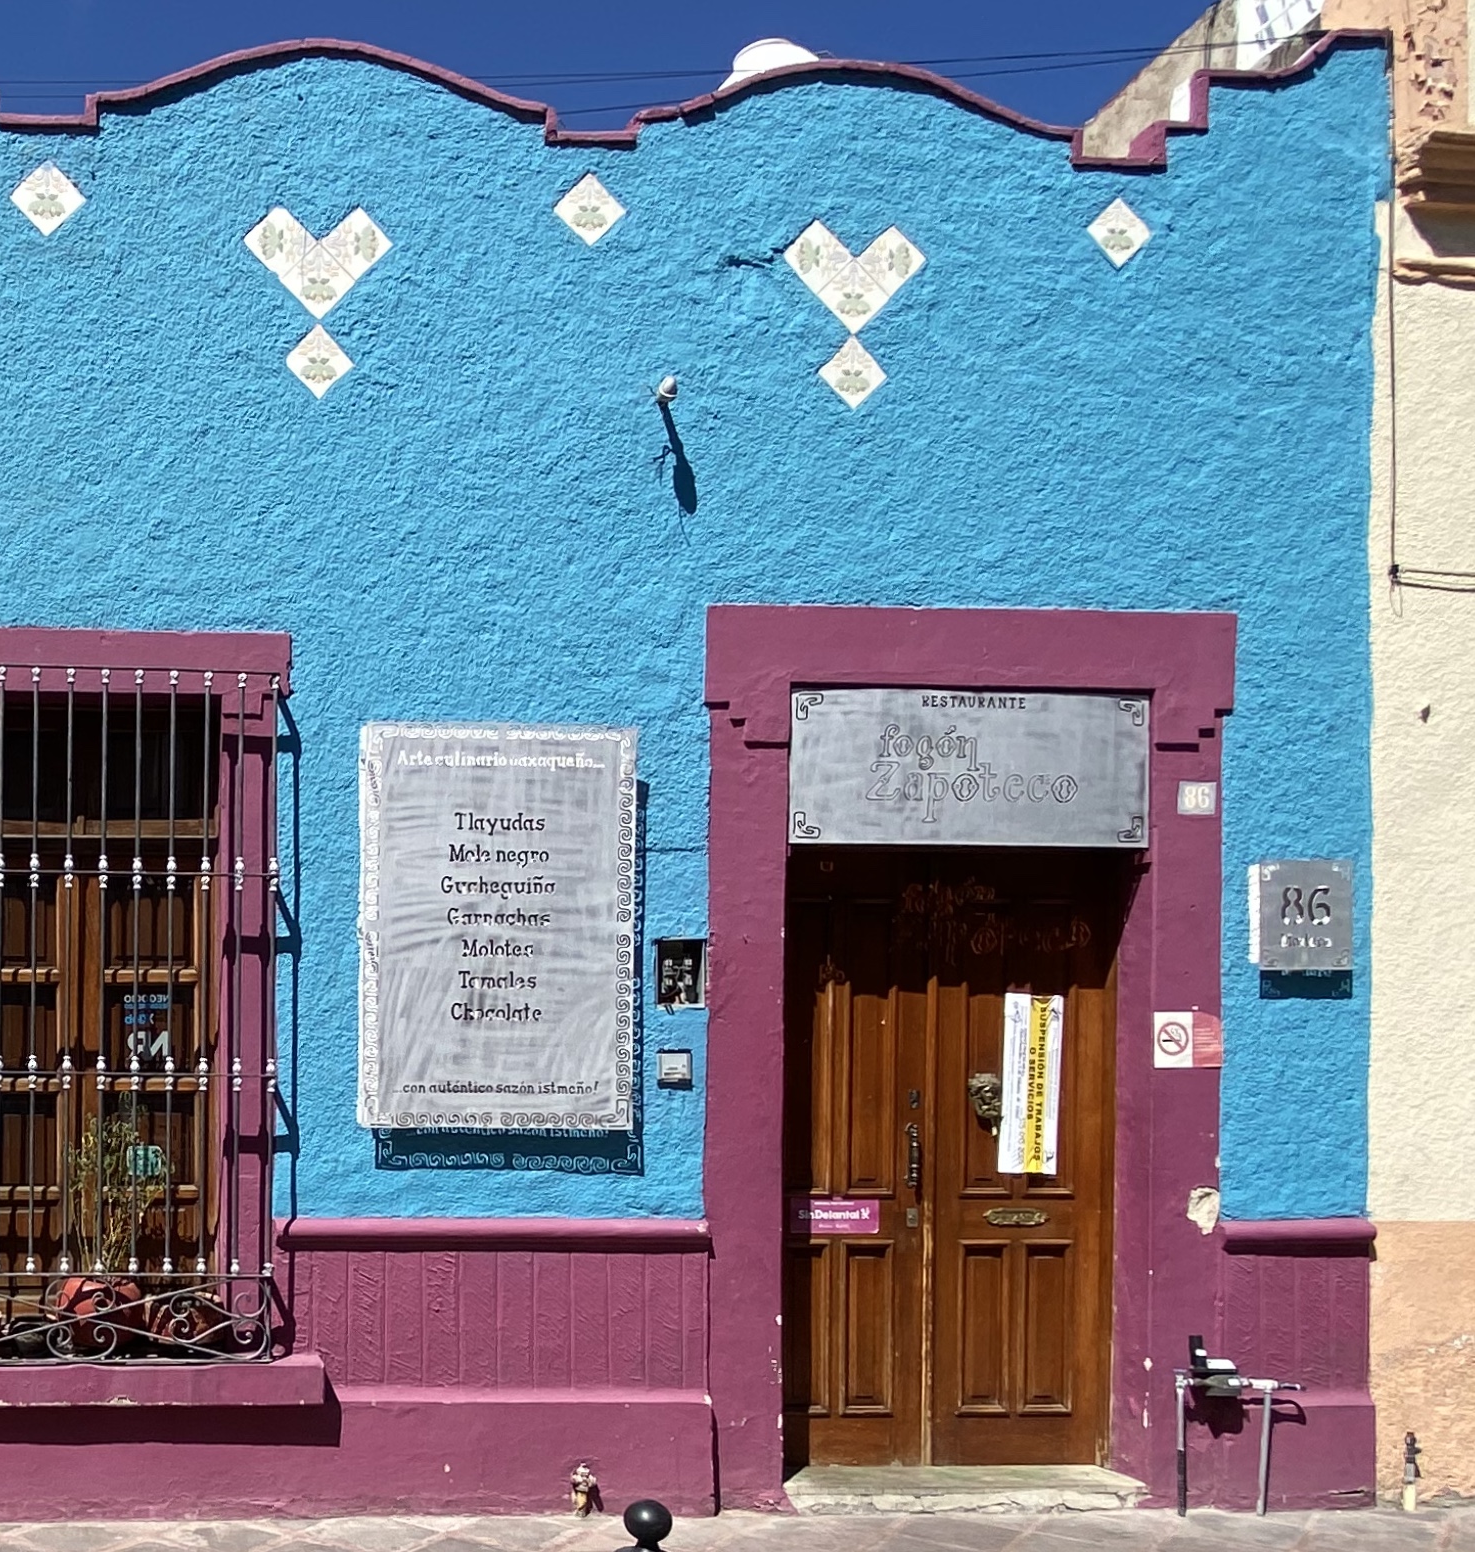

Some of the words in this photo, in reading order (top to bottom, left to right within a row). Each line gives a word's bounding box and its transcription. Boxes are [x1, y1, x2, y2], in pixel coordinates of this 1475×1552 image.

[921, 695, 1026, 709] RESTAURANTE
[879, 723, 980, 771] fogón
[397, 750, 432, 767] Arte
[434, 750, 508, 768] culinario
[865, 760, 1079, 823] Zapoteco
[1183, 784, 1210, 809] 86
[454, 812, 546, 836] Tlayudas
[448, 844, 491, 862] Mole
[495, 850, 550, 868] negro
[1281, 885, 1331, 926] 86
[447, 907, 551, 926] Garnachas
[461, 938, 534, 957] Molotes
[458, 970, 537, 989] Tamales
[451, 1002, 542, 1021] Chocolate
[429, 1080, 494, 1094] auténtico
[495, 1080, 535, 1094] sazón
[537, 1080, 599, 1095] istmeño!
[1026, 1058, 1036, 1120] SERVICIOS
[1035, 1083, 1044, 1097] DE
[1033, 1101, 1044, 1162] TRABAJOS
